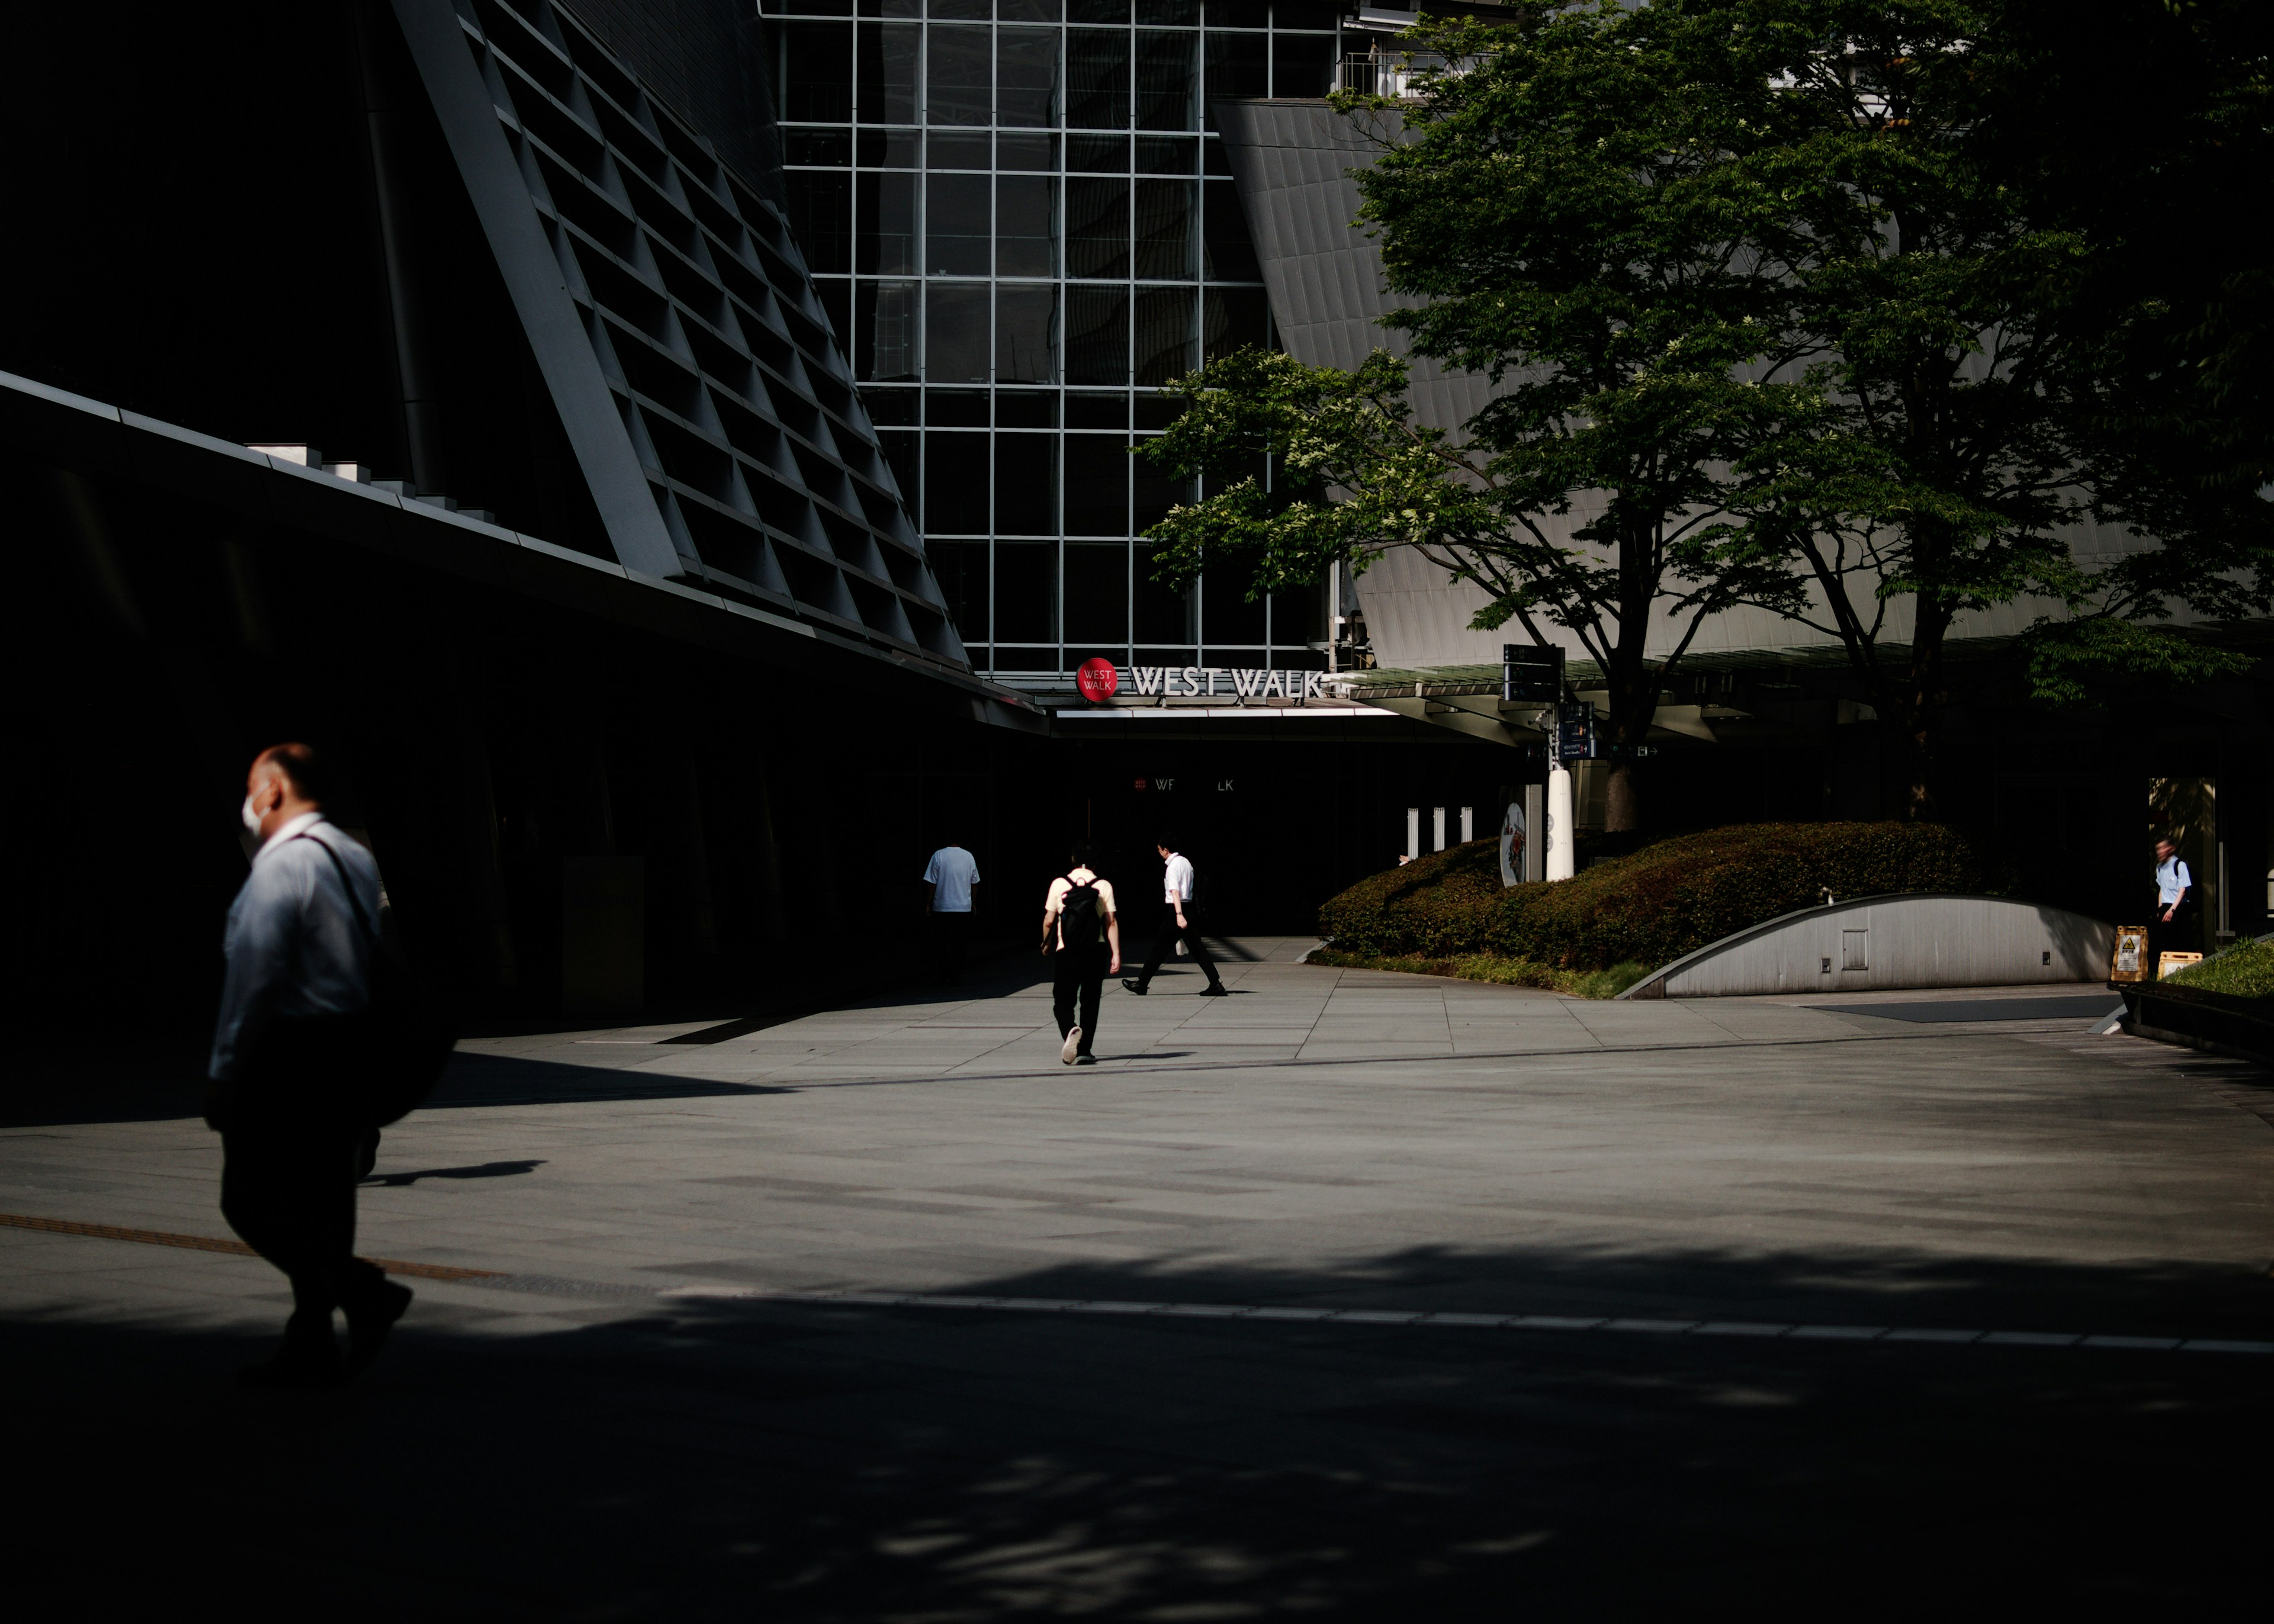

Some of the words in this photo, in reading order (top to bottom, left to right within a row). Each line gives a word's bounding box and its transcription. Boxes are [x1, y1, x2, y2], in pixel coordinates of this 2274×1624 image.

[1084, 670, 1112, 680] WEST
[1084, 680, 1112, 690] WALK
[1129, 667, 1221, 696] WEST
[1229, 668, 1324, 698] WALK
